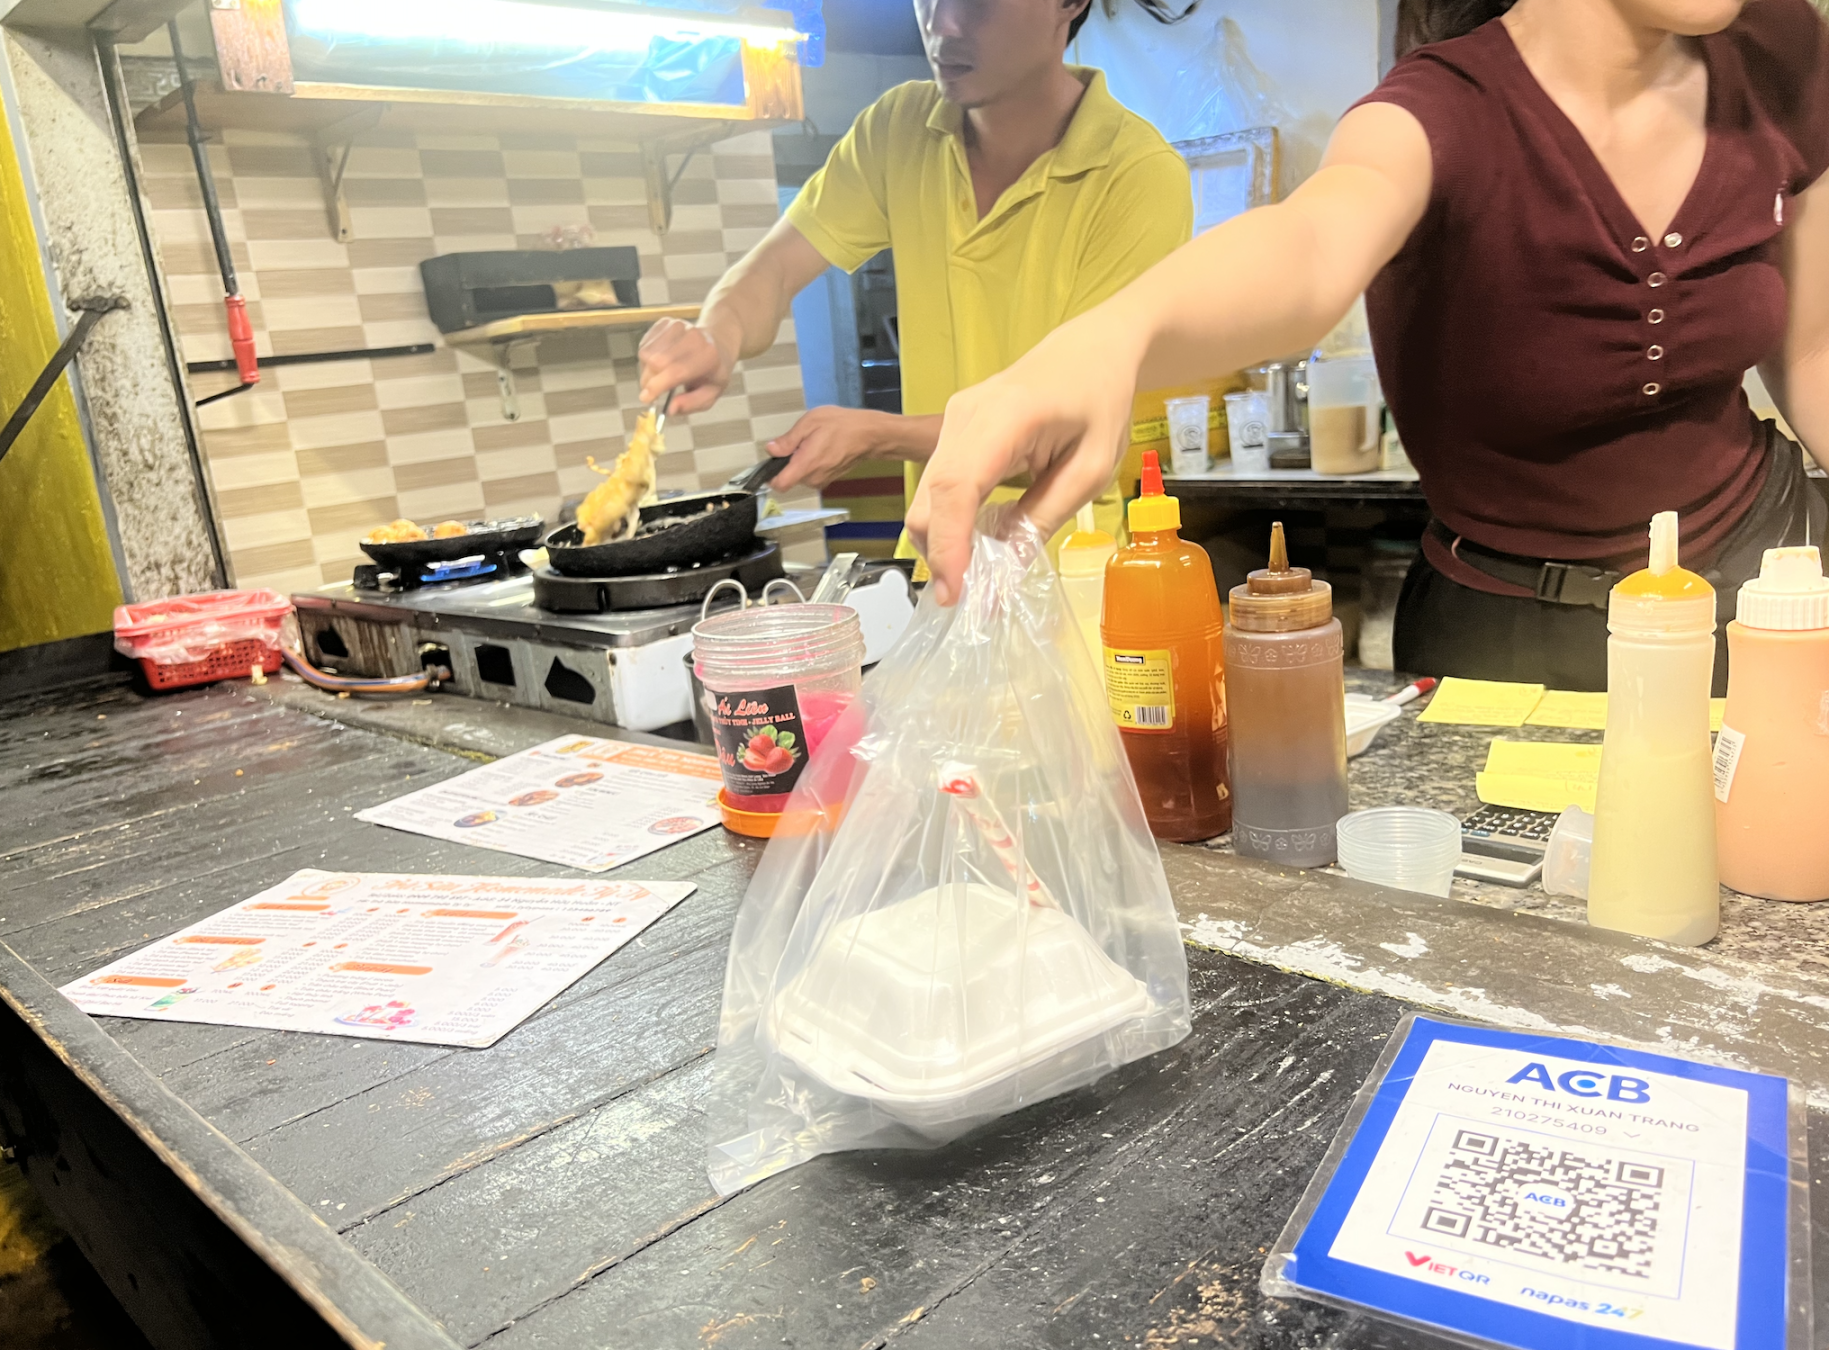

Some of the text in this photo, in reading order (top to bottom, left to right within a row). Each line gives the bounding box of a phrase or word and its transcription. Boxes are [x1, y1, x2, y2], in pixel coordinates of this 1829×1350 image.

[733, 698, 769, 717] Liên
[752, 716, 775, 725] JELLY
[775, 712, 796, 723] BALL
[1505, 1061, 1651, 1105] ACB
[1447, 1082, 1700, 1133] NGUYEN THI XUAN TRANG
[1490, 1106, 1608, 1136] 210275409
[1523, 1191, 1567, 1208] ACB
[1519, 1286, 1590, 1312] napas
